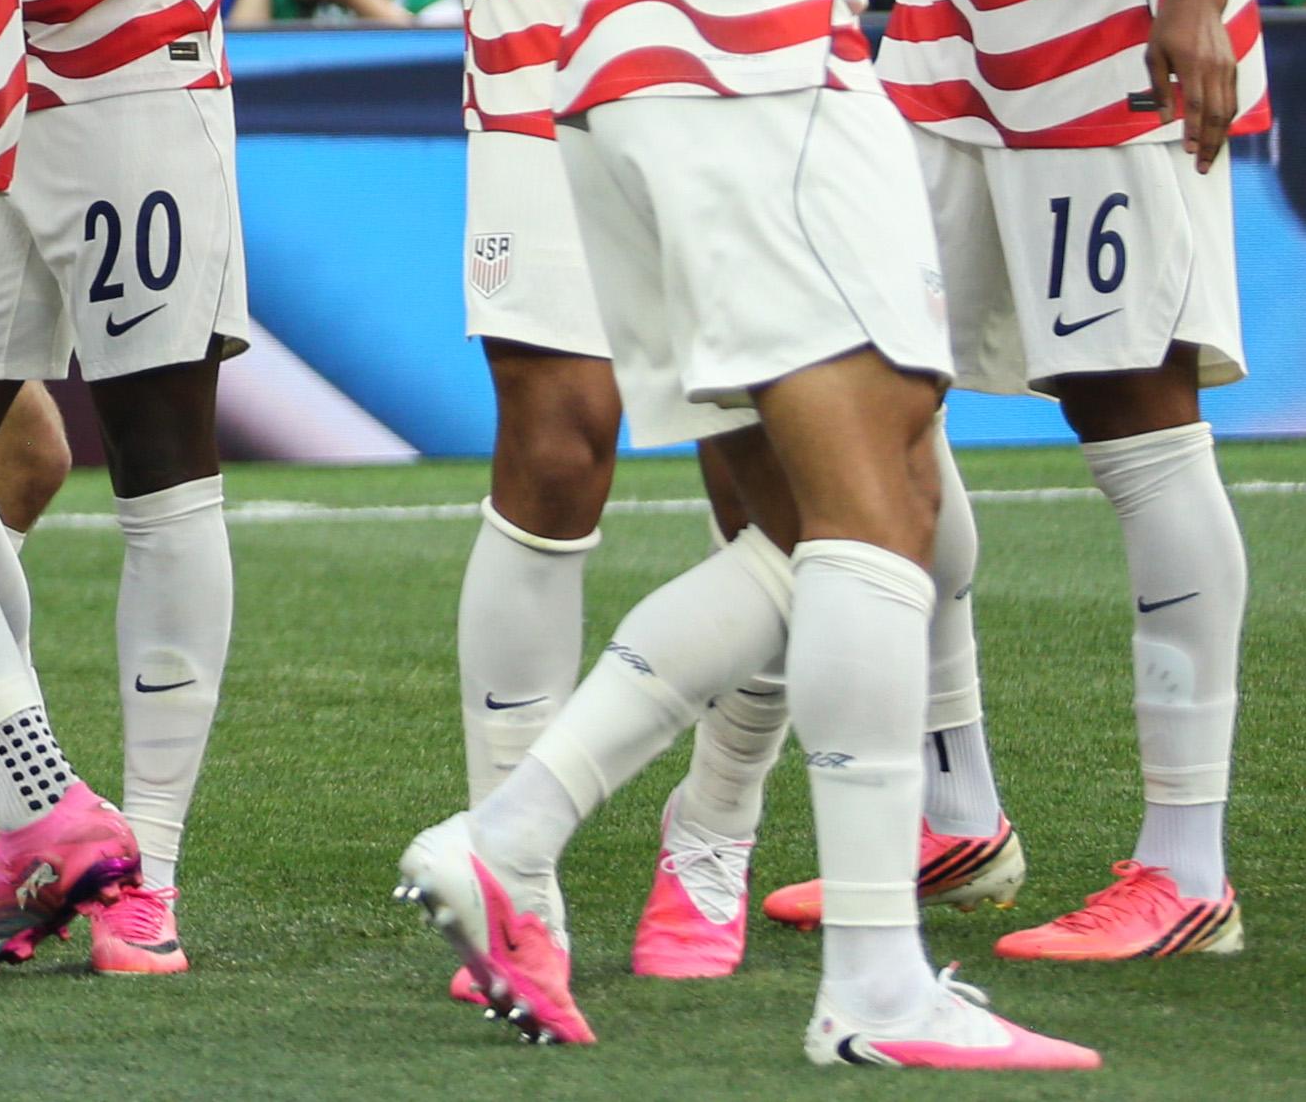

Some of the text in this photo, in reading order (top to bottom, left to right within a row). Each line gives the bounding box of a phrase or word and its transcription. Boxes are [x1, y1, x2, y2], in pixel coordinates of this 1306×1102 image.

[84, 190, 181, 303] 20
[475, 237, 509, 261] USA
[1048, 192, 1129, 302] 16
